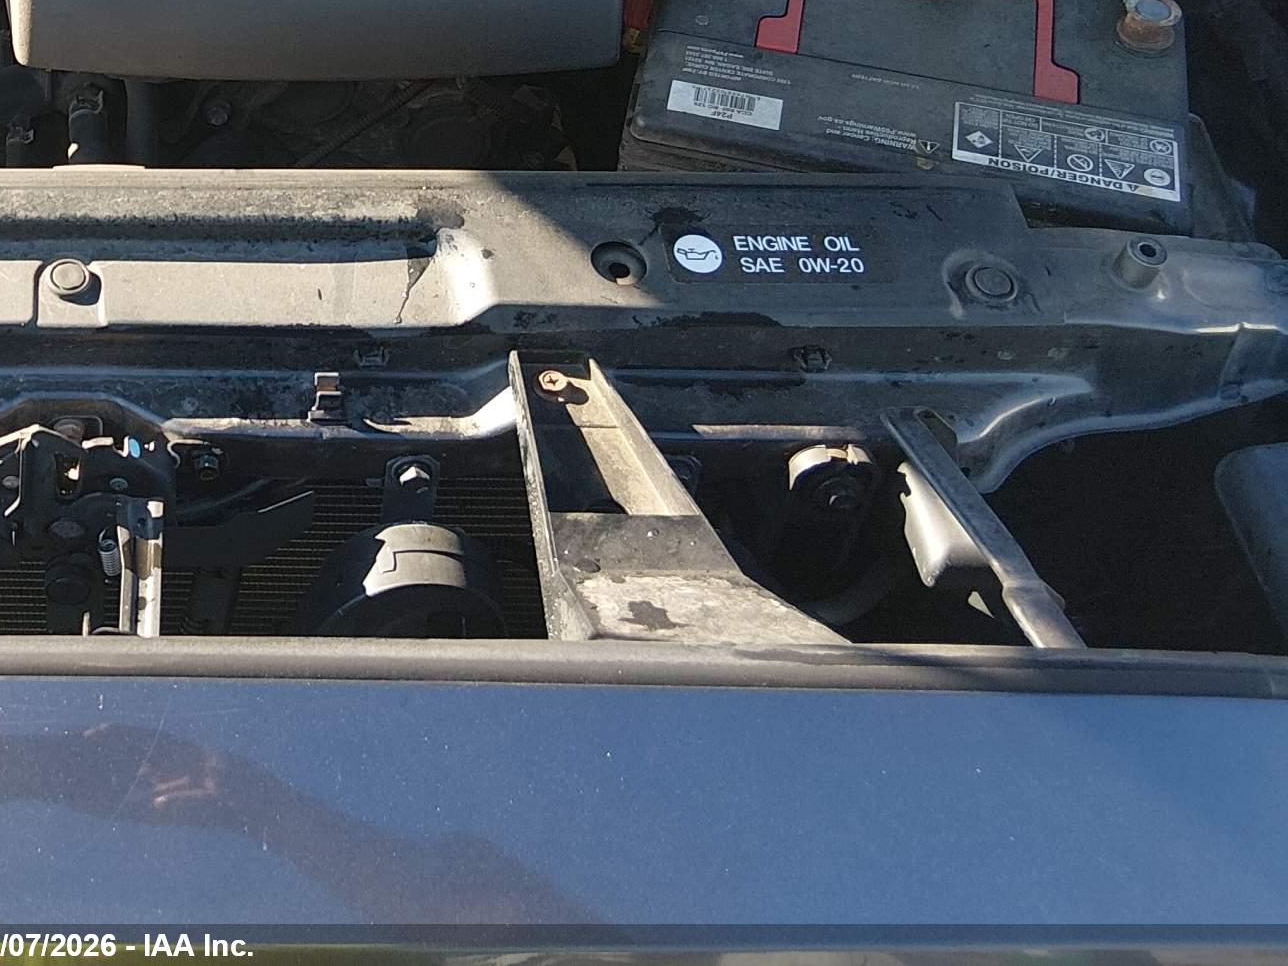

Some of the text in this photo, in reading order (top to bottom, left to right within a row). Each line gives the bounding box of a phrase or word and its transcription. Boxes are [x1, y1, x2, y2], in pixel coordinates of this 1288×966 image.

[712, 110, 733, 120] P24F
[988, 156, 1129, 191] DANGER/POISON
[733, 235, 861, 252] ENGINE OIL
[740, 257, 865, 273] SAE 0W-20
